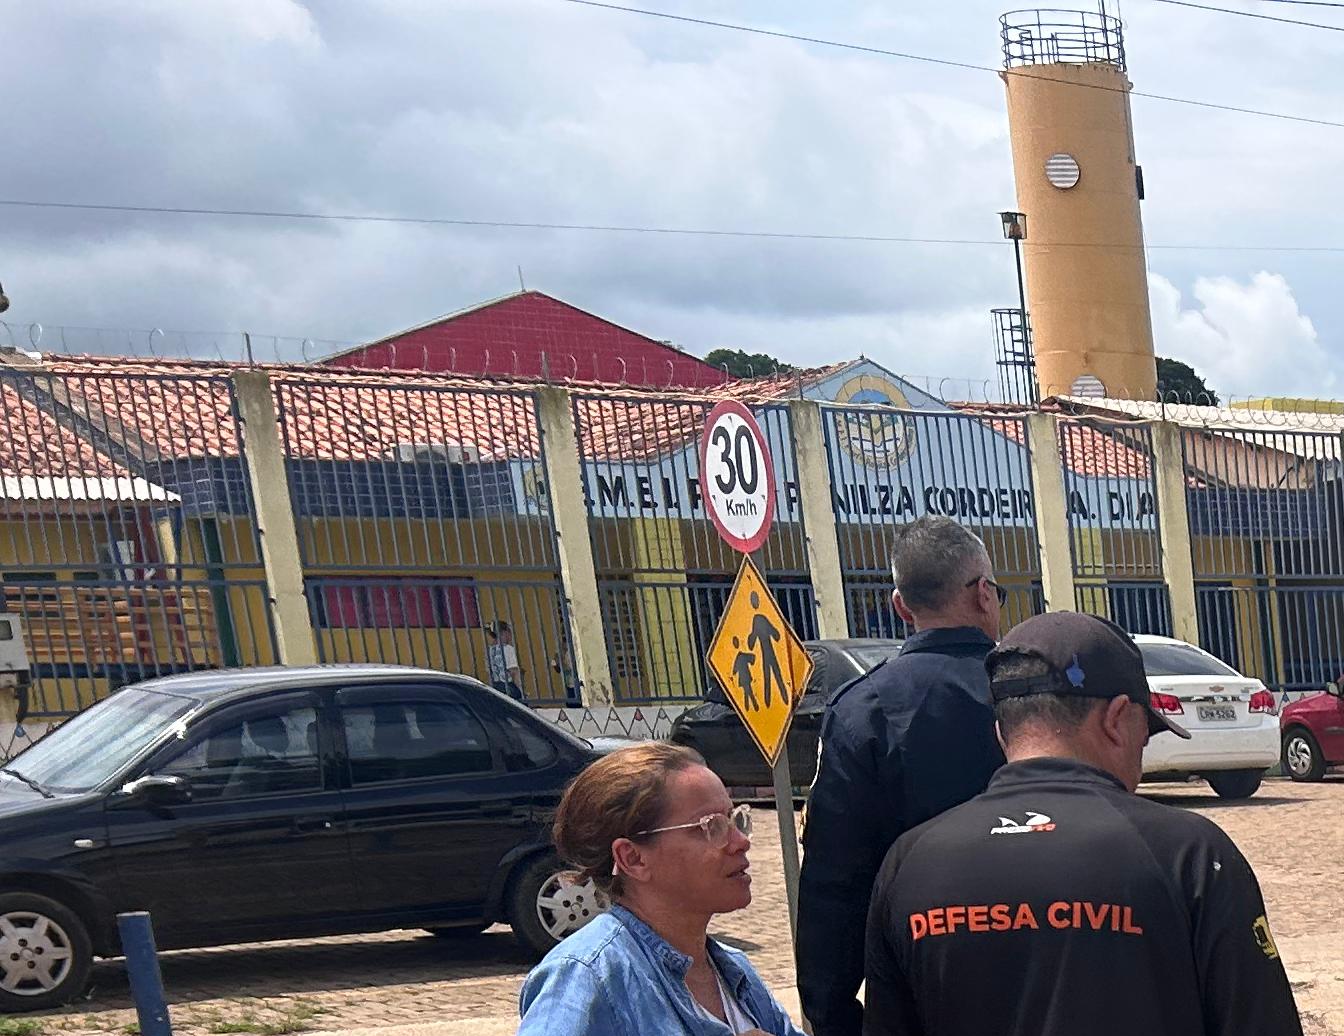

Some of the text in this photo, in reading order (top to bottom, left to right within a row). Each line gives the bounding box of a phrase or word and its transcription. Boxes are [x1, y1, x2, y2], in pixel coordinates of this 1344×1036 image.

[711, 425, 758, 495] 30
[726, 498, 757, 517] Km/h
[831, 484, 914, 516] NILZA
[924, 486, 1033, 519] CORDEIR
[1107, 491, 1155, 521] DIA
[910, 900, 1144, 941] DEFESA CIVIL
